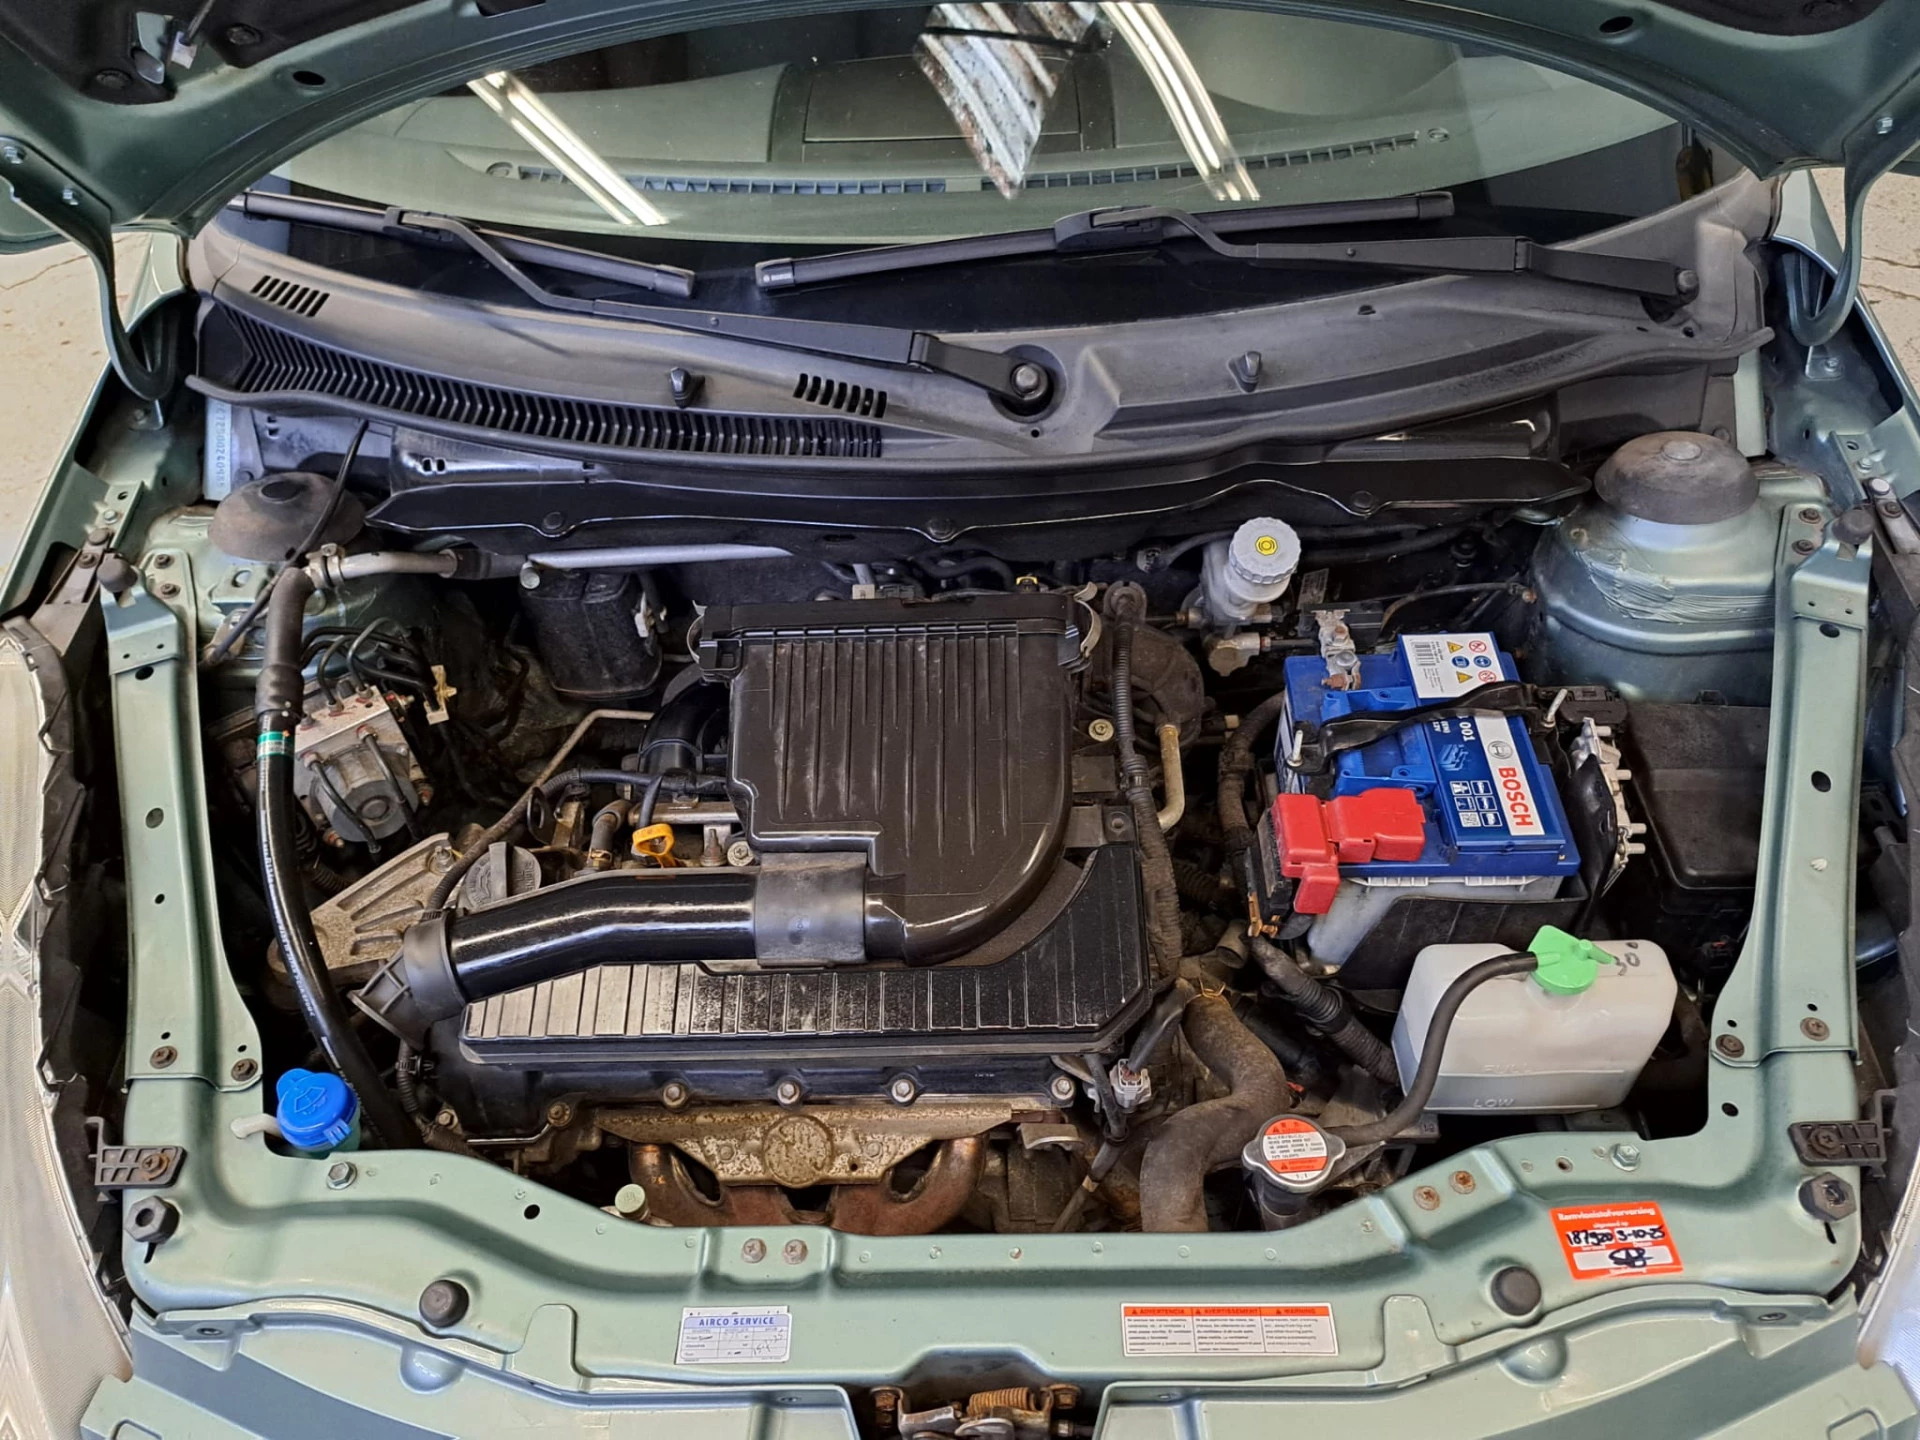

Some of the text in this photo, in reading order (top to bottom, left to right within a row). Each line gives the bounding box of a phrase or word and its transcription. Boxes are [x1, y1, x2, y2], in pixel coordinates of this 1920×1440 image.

[1498, 767, 1534, 826] BOSCH
[1473, 1098, 1516, 1109] LOW
[699, 1317, 775, 1327] AIRCO SERVICE
